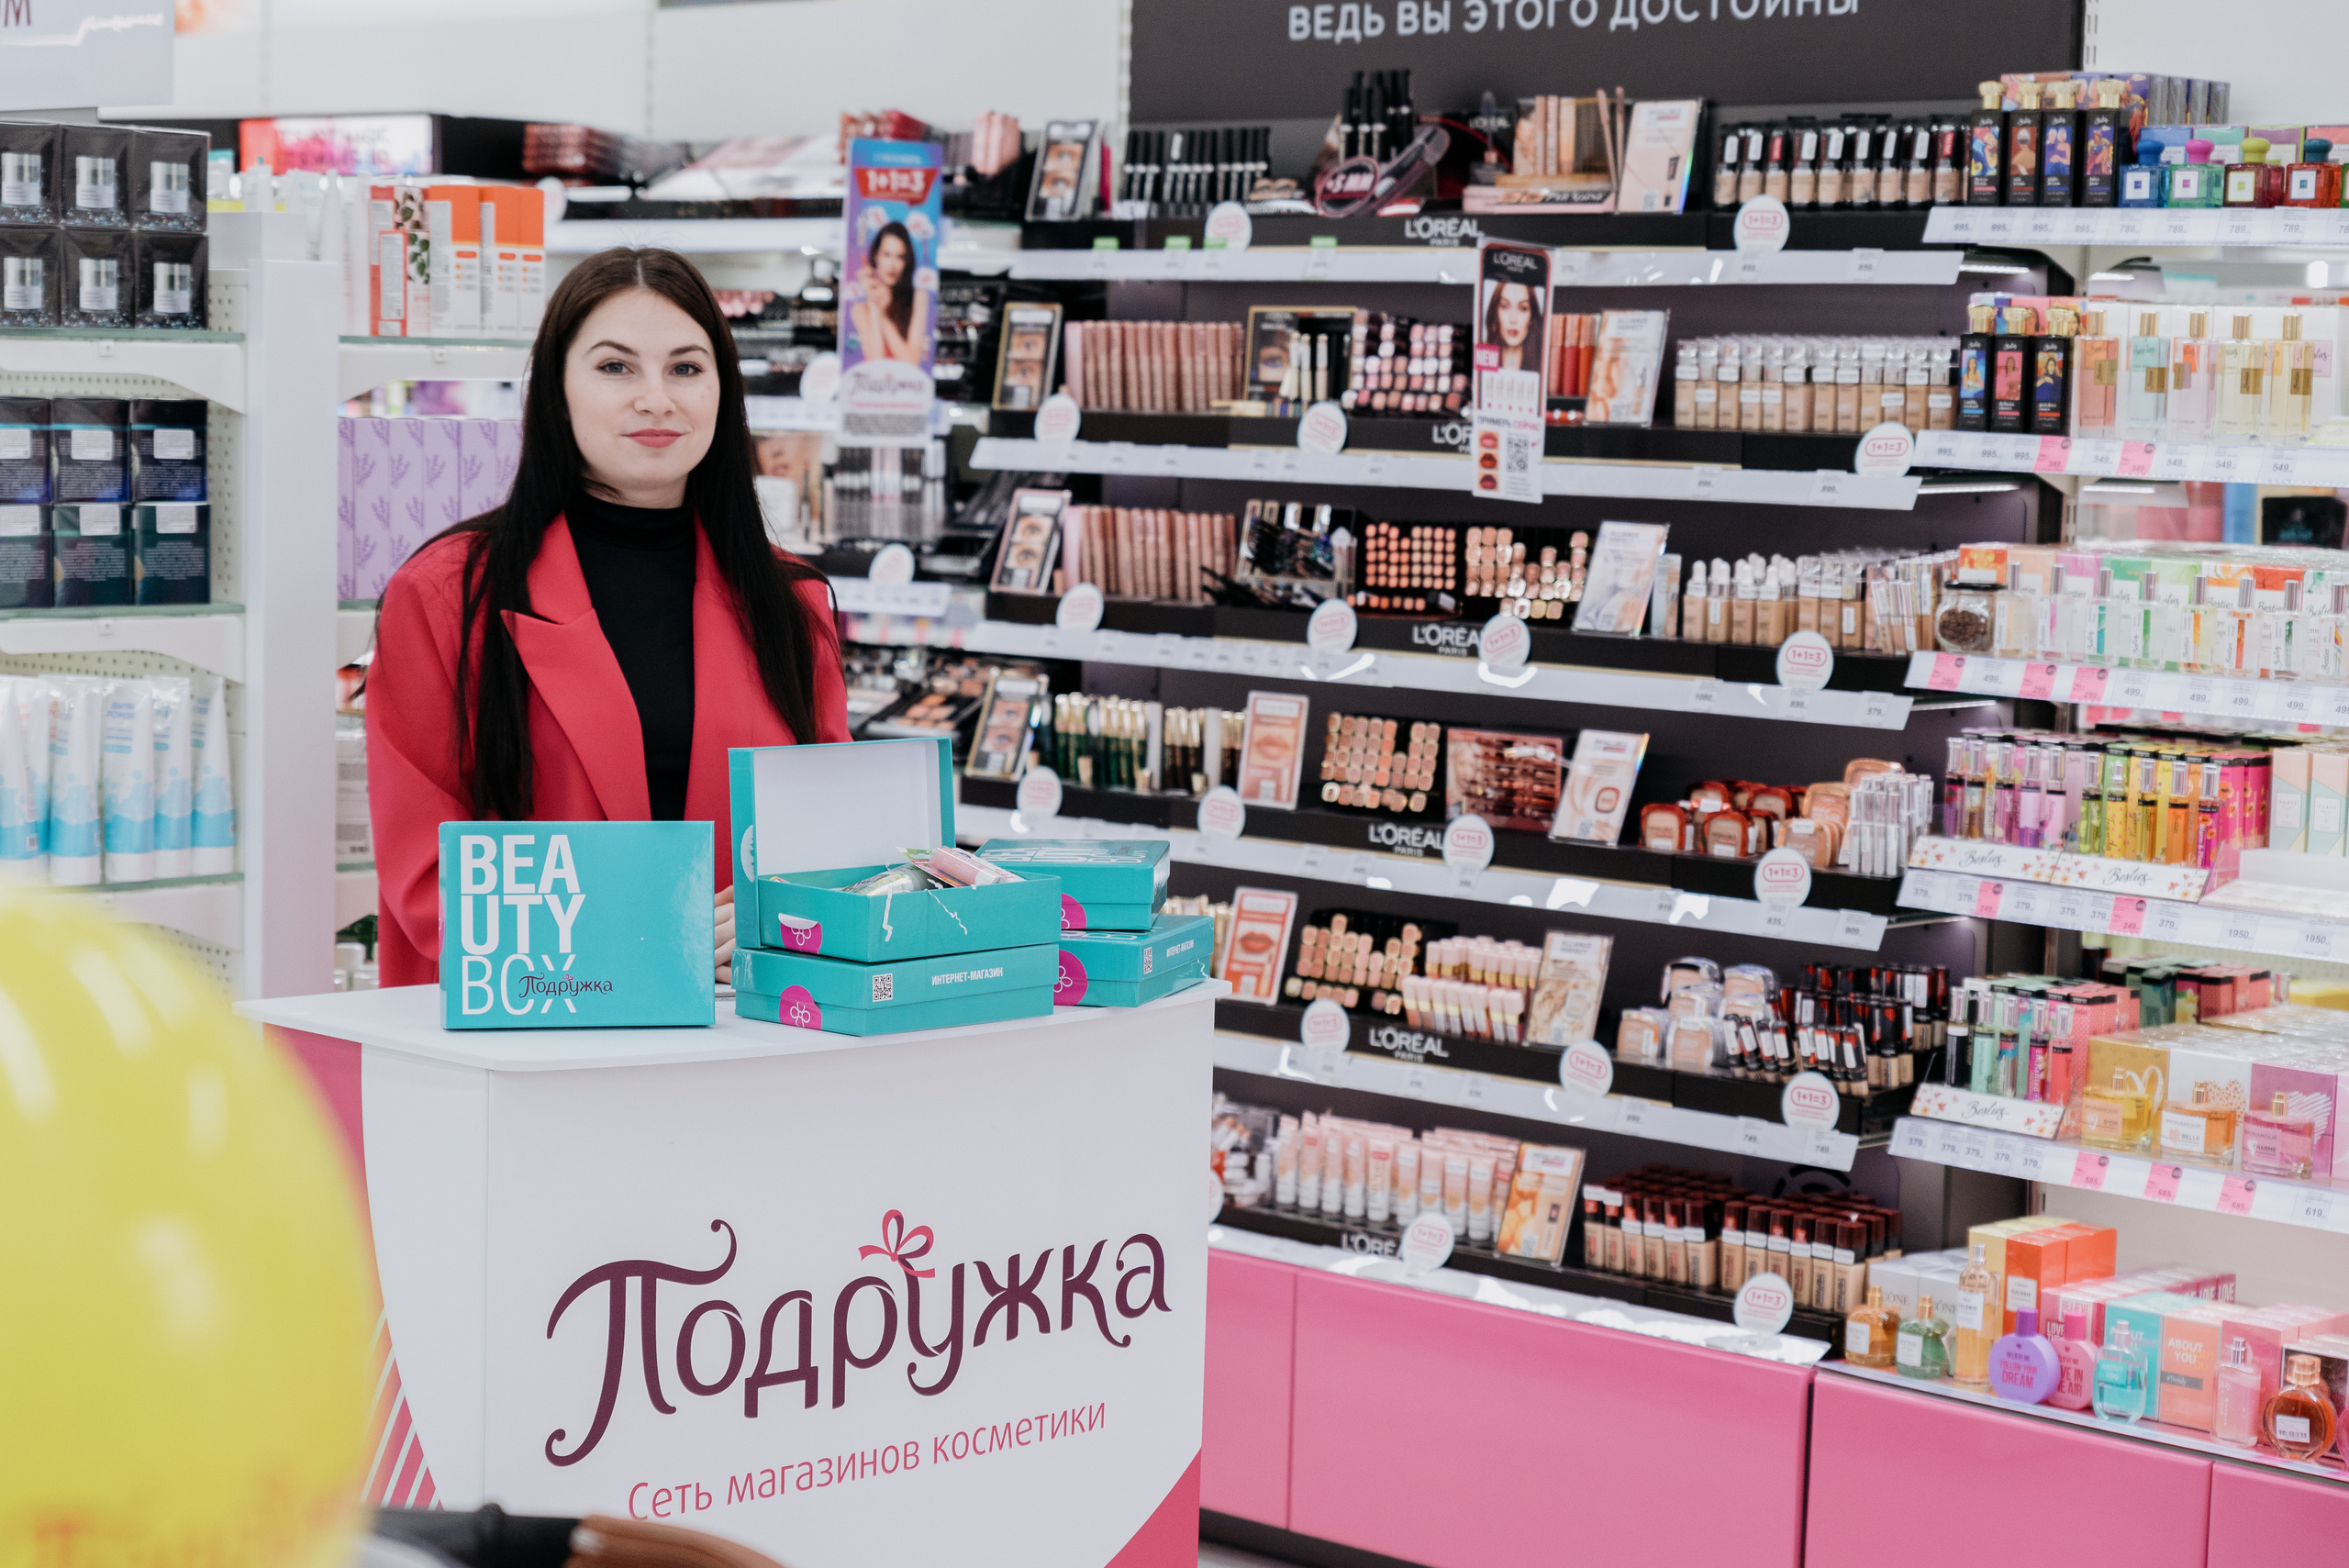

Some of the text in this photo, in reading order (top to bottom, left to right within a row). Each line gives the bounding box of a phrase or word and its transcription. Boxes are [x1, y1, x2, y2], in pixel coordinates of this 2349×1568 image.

[1287, 3, 1386, 45] ВЕДЬ
[1397, 0, 1451, 35] ВЫ
[1463, 0, 1598, 32] ЭТОГО
[1749, 215, 1778, 226] 1+1=3
[1405, 217, 1485, 239] L'ORÉAL
[2230, 224, 2246, 234] 789
[2283, 223, 2300, 233] 789
[1475, 349, 1499, 367] NEW
[1477, 416, 1512, 428] ПРИМЕРЬ
[1872, 441, 1904, 452] 1+1=3
[1937, 447, 1953, 457] 995
[1981, 450, 1998, 460] 995
[2014, 450, 2031, 461] 995
[2094, 454, 2110, 464] 549
[2166, 458, 2183, 468] 549
[2216, 460, 2232, 470] 549
[2273, 462, 2289, 473] 549
[2257, 601, 2285, 614] Bestie
[1412, 623, 1480, 647] L'ORÉA
[1438, 646, 1467, 657] PARIS
[1792, 649, 1821, 662] 1+1=3
[1983, 674, 1998, 684] 499
[2125, 687, 2141, 697] 499
[2190, 693, 2207, 704] 499
[2232, 696, 2249, 706] 499
[2287, 701, 2304, 711] 499
[1867, 707, 1883, 717] 579
[460, 834, 581, 895] BEA
[1959, 849, 2007, 869] Besties
[1767, 867, 1798, 878] 1+1=3
[2103, 867, 2153, 887] Besties
[1913, 888, 1928, 897] 379
[1957, 894, 1974, 904] 379
[2014, 900, 2031, 911] 379
[2059, 906, 2076, 917] 379
[2090, 909, 2107, 920] 379
[461, 893, 586, 956] UTY
[1767, 917, 1782, 926] 835
[2123, 922, 2137, 930] 249
[2159, 918, 2176, 929] 379
[1844, 926, 1860, 936] 909
[2228, 928, 2250, 940] 1950
[2304, 933, 2327, 945] 1950
[1166, 939, 1195, 959] ИНТЕРНЕТ-МАГАЗИН
[931, 966, 1004, 985] ИНТЕРНЕТ-МАГАЗИН
[518, 972, 614, 999] Подружка
[1368, 1026, 1450, 1058] L'ORÉAL
[1394, 1051, 1423, 1063] PARIS
[1574, 1055, 1604, 1073] 1+1=3
[2033, 1049, 2043, 1092] Enchanted
[1796, 1091, 1828, 1106] 1+1=3
[1961, 1101, 2009, 1120] Besties
[1908, 1138, 1923, 1147] 379
[2181, 1134, 2201, 1142] BELLE
[1814, 1144, 1831, 1153] 749
[1940, 1143, 1956, 1153] 379
[1965, 1147, 1981, 1157] 379
[1994, 1151, 2010, 1162] 379
[2022, 1158, 2039, 1168] 379
[2232, 1202, 2246, 1210] 585
[2305, 1207, 2322, 1218] 619
[1751, 1290, 1781, 1306] 1+1=3
[2220, 1284, 2235, 1301] LOVE
[544, 1213, 1173, 1468] Подружка
[2168, 1338, 2204, 1352] ABOUT
[2175, 1352, 2198, 1364] YOU
[1999, 1360, 2038, 1375] FOLLOW YOUR
[2001, 1372, 2034, 1388] DREAM
[2074, 1369, 2084, 1382] IN
[2067, 1383, 2083, 1396] AIR
[628, 1401, 1107, 1521] Сеть магазинов косметики
